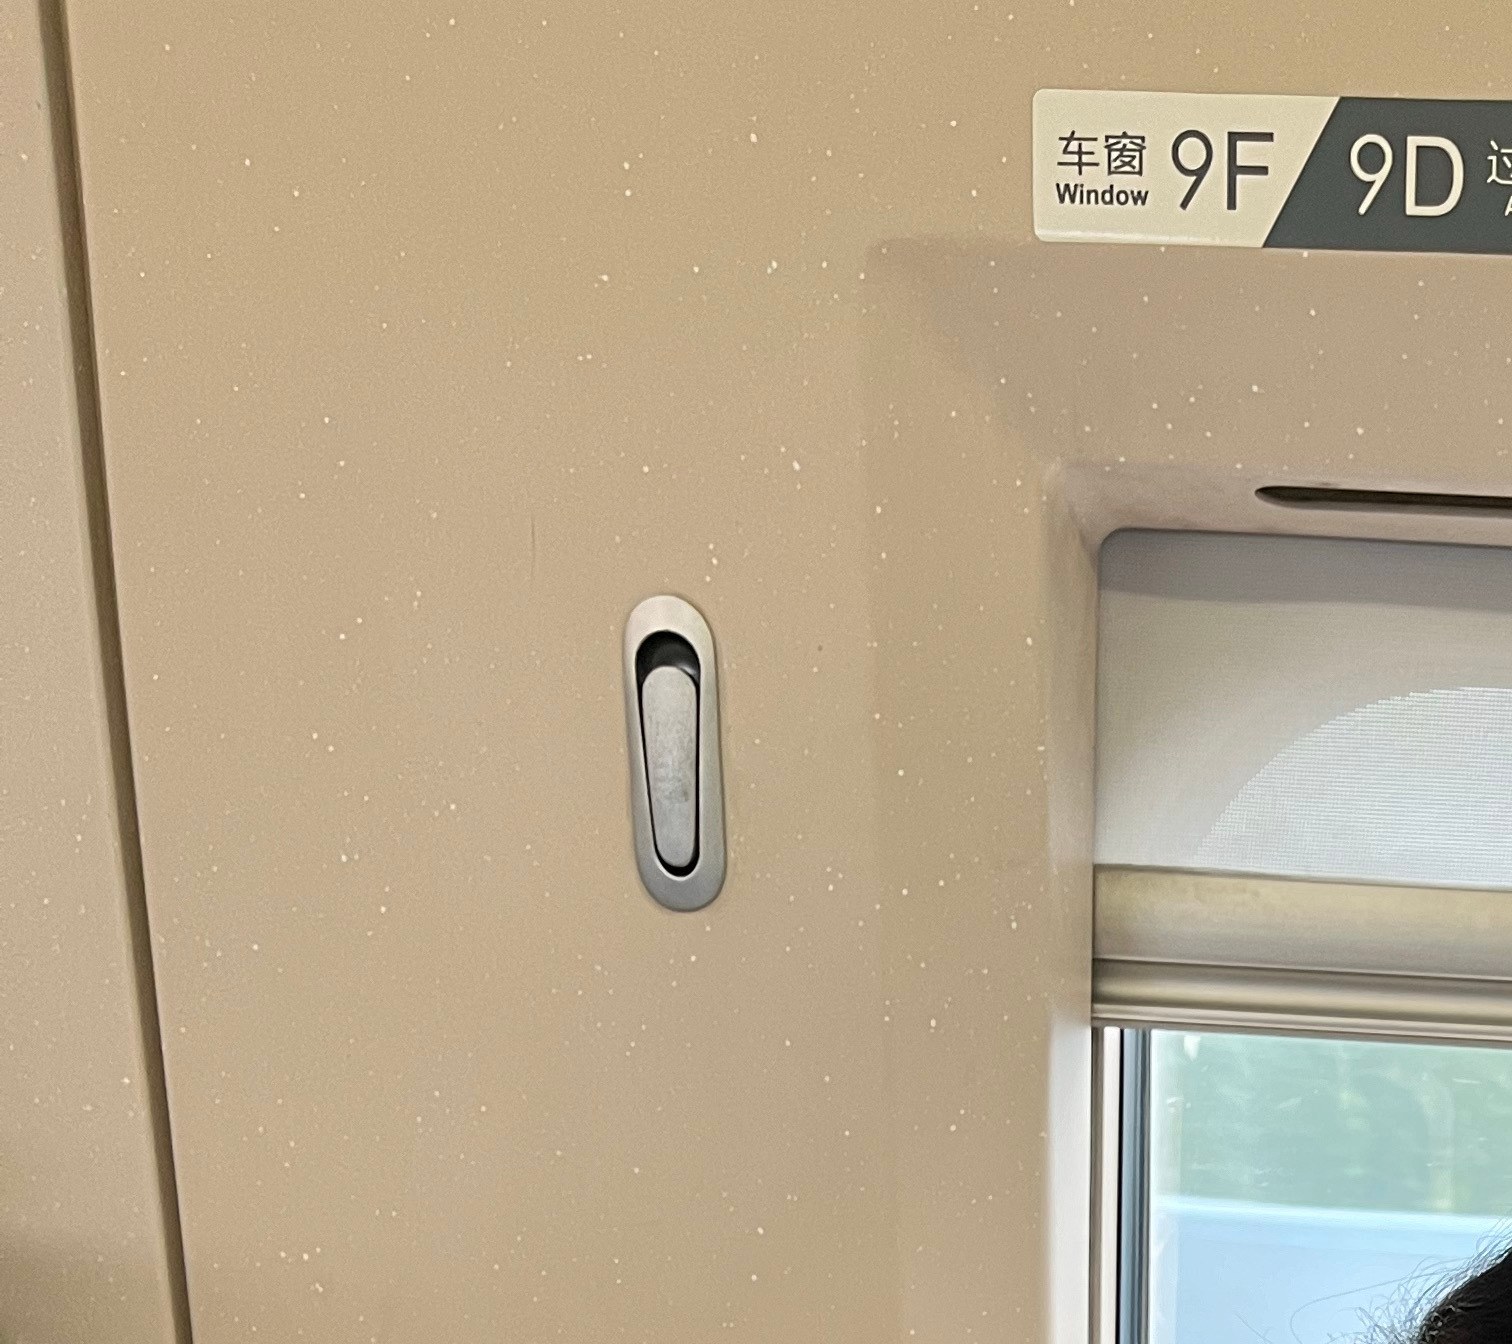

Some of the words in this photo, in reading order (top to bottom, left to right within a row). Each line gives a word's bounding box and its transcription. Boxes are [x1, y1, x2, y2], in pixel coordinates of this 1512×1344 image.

[1056, 129, 1147, 177] 车窗
[1170, 129, 1275, 211] 9F
[1350, 133, 1464, 216] 9D
[1055, 182, 1150, 207] Window
